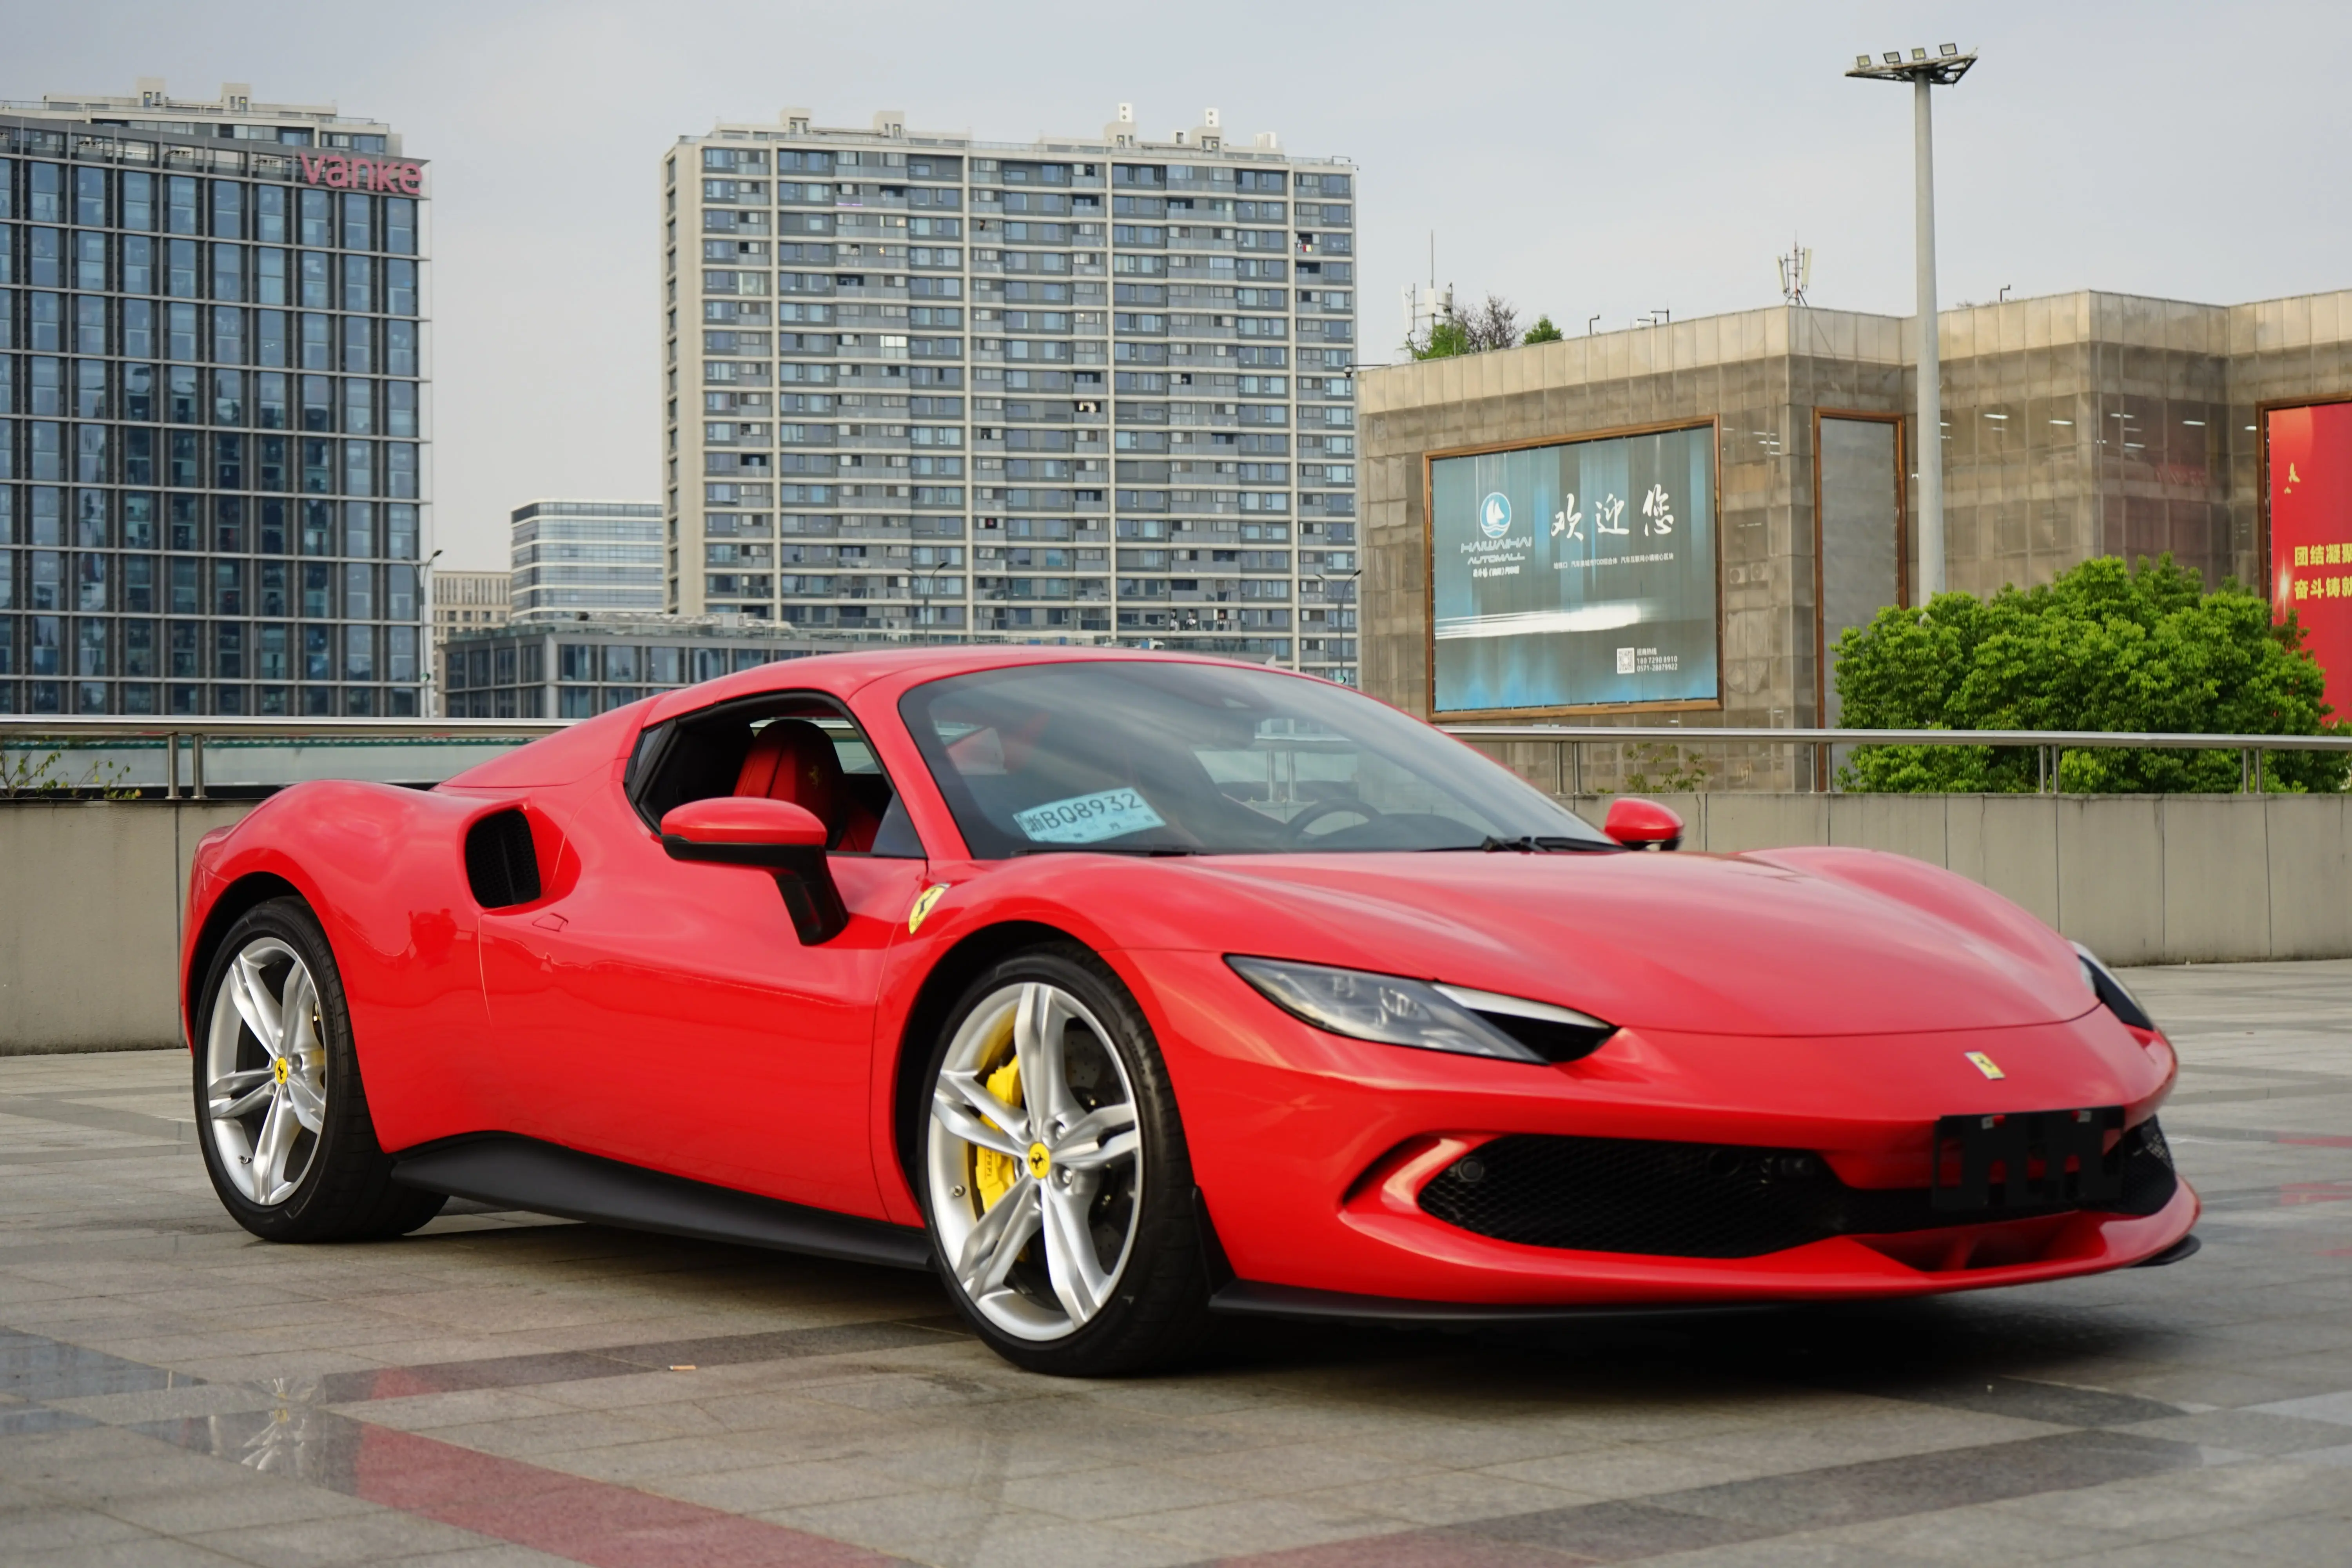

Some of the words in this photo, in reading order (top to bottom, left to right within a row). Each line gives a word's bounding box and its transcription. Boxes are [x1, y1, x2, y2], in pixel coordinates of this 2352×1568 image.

[300, 152, 422, 194] vanke
[1551, 483, 1674, 542] 欢迎您
[1467, 552, 1525, 565] AUTOMALL
